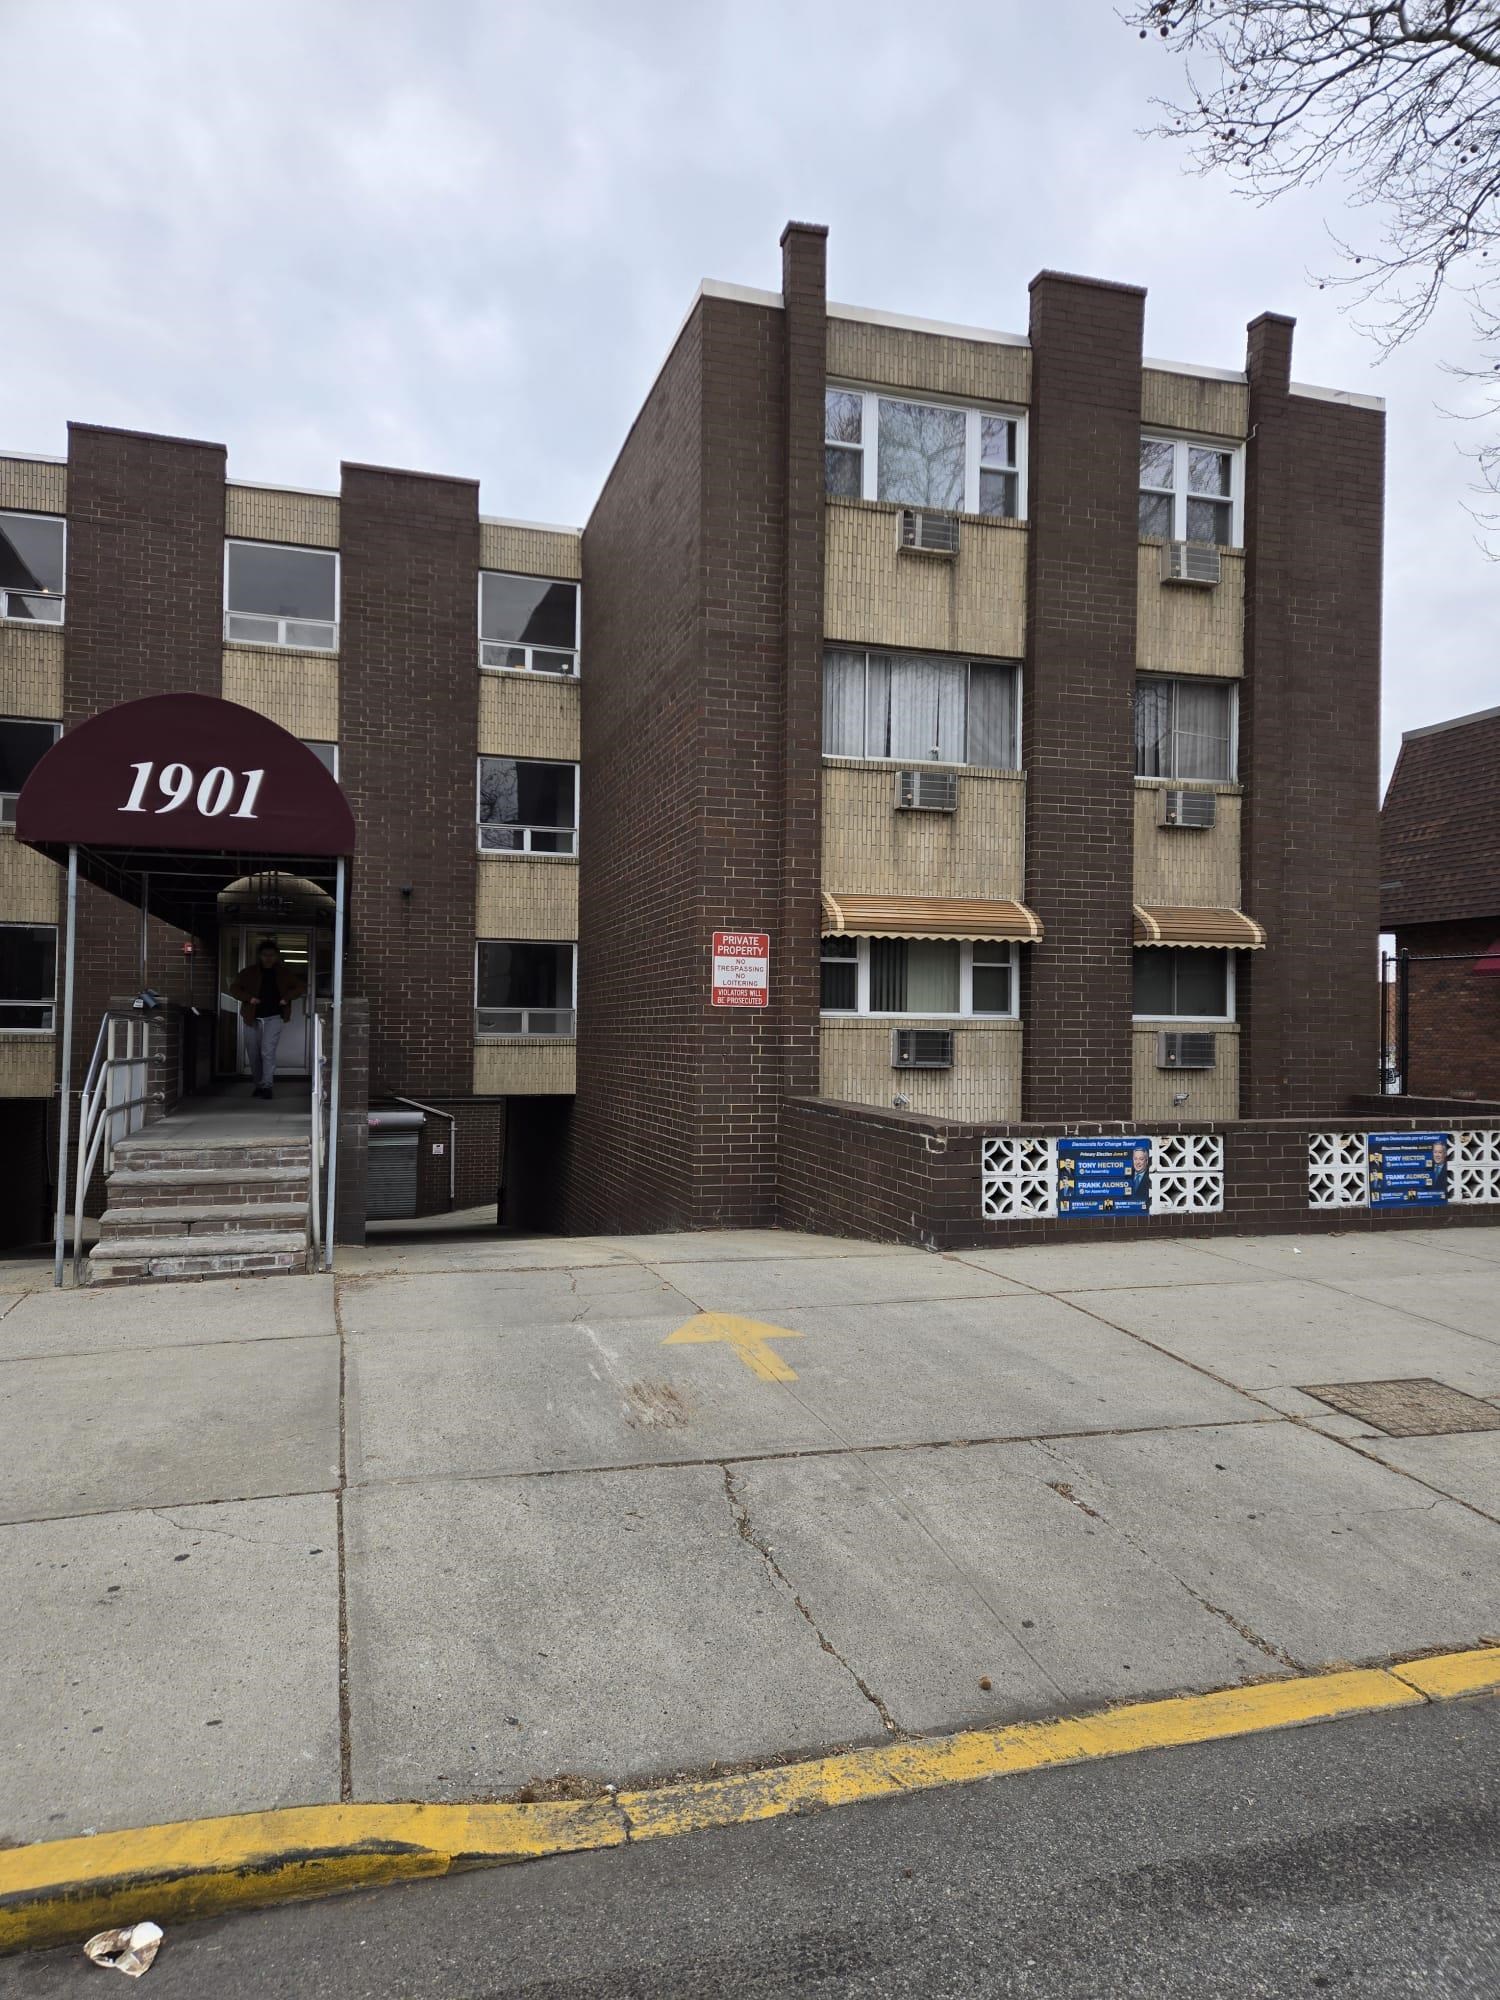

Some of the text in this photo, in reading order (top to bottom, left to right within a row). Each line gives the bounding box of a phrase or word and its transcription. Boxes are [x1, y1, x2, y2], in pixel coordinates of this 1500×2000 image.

[117, 761, 266, 819] 1901
[723, 936, 759, 945] PRIVATE
[718, 946, 763, 955] PROPERTY
